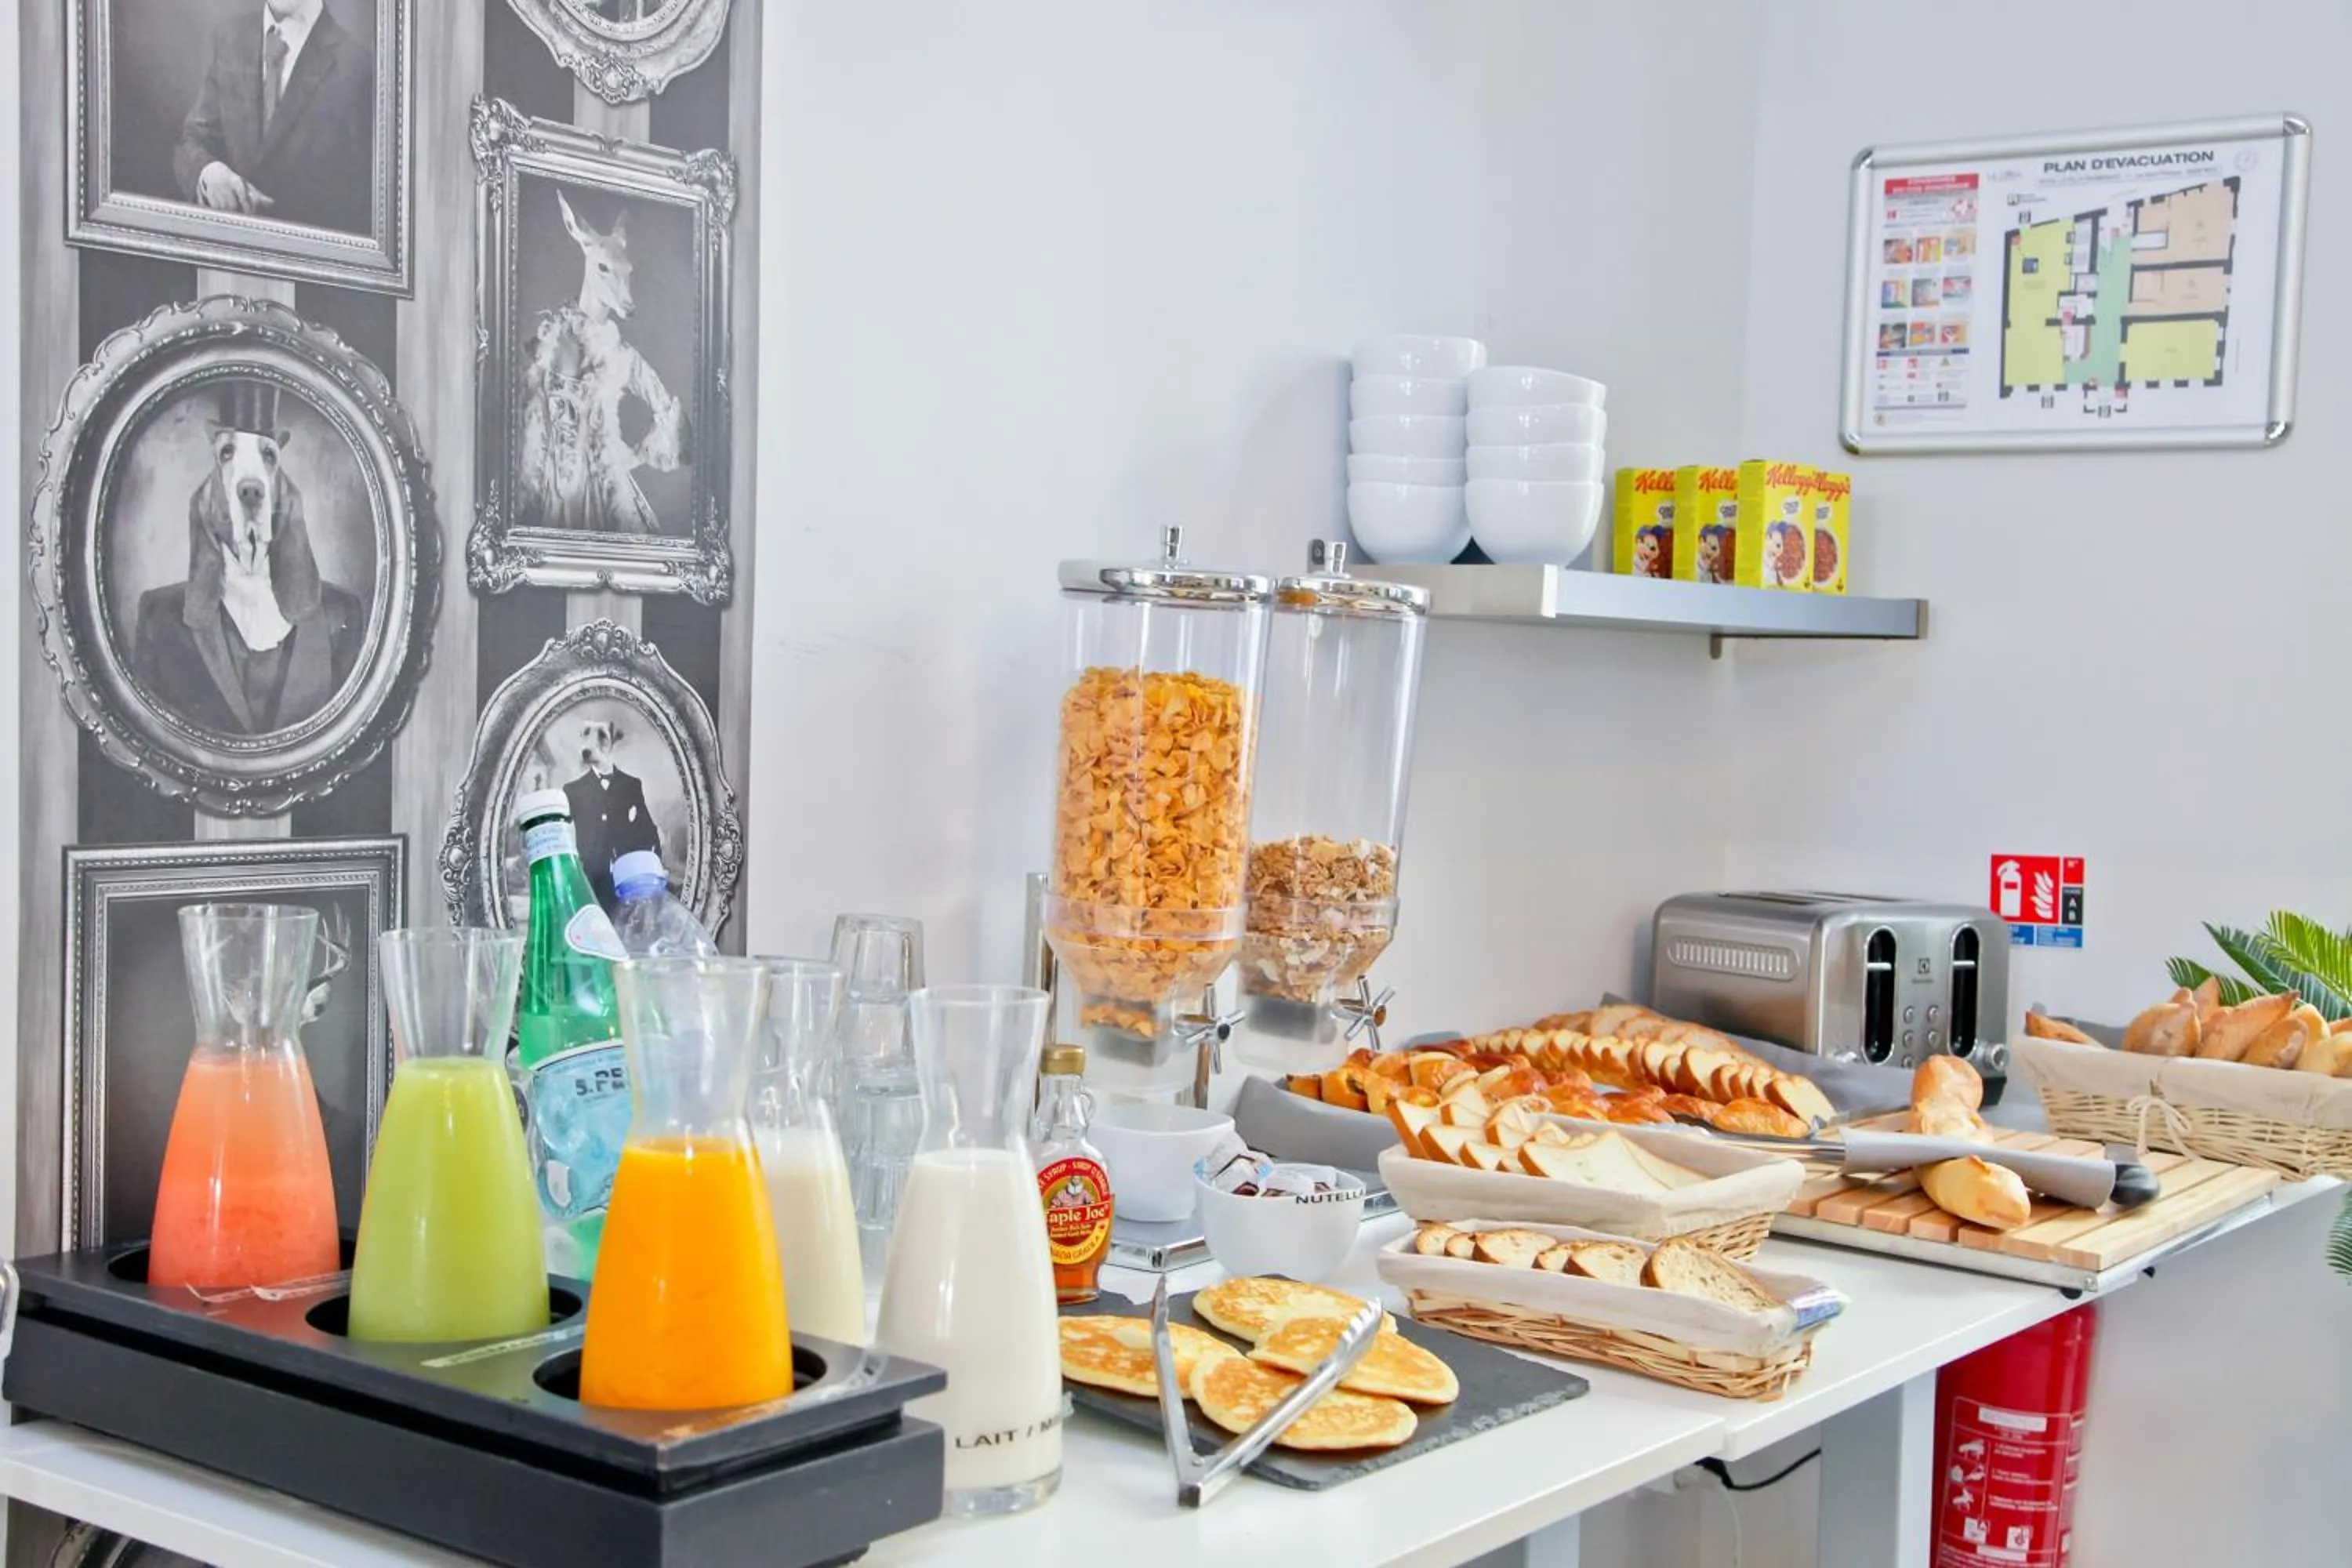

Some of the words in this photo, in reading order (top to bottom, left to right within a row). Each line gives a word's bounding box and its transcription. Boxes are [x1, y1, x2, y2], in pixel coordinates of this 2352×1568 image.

[2043, 160, 2086, 174] PLAN
[2069, 898, 2077, 908] A
[1295, 1187, 1364, 1205] NUTELLA
[1046, 1208, 1082, 1225] aple
[1085, 1206, 1106, 1221] Joe
[956, 1429, 1018, 1449] LAIT
